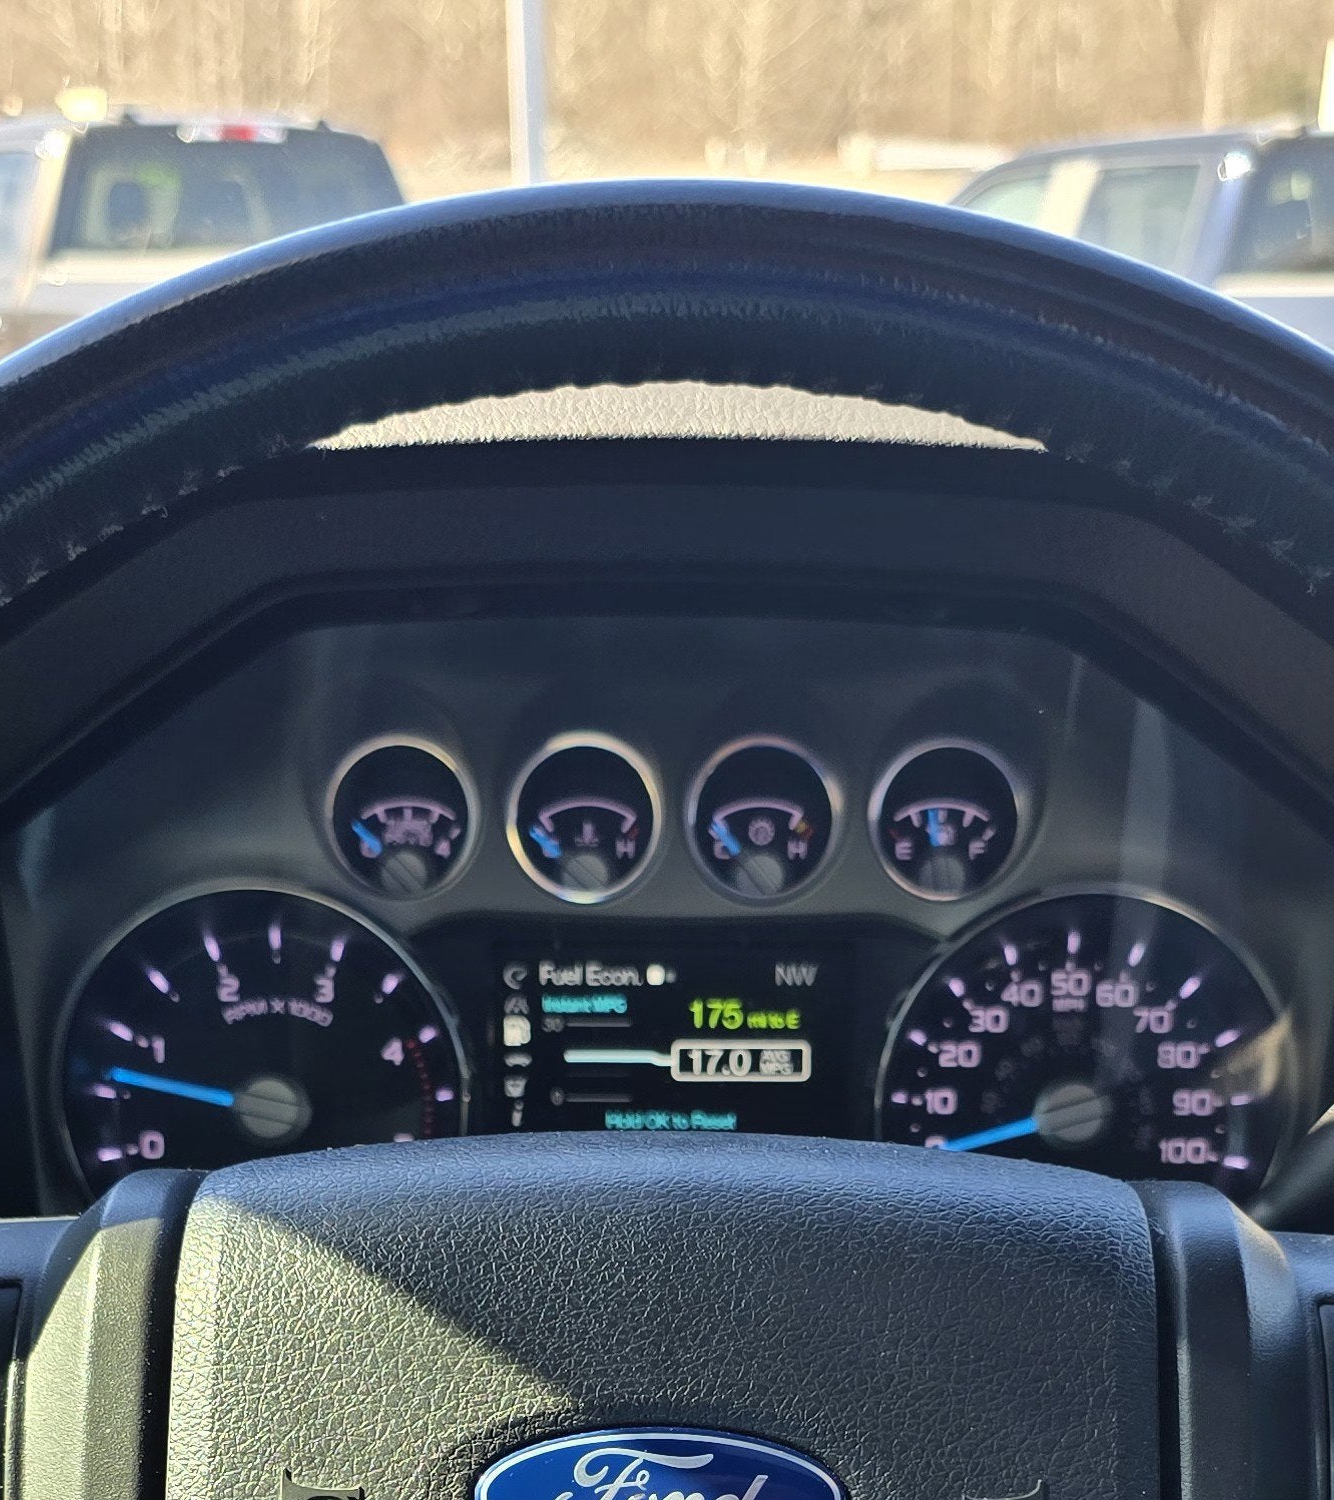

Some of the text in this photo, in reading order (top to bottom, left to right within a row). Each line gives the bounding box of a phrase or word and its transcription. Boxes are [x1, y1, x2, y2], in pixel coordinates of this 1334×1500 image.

[217, 973, 241, 1002] 2
[313, 973, 335, 1002] 3
[539, 960, 584, 986] Fuel
[774, 961, 818, 987] NW
[1050, 968, 1093, 997] 50
[1000, 979, 1045, 1008] 40
[1095, 979, 1140, 1008] 60
[688, 998, 744, 1030] 175
[968, 1005, 1010, 1034] 30
[1133, 1004, 1174, 1034] 70
[380, 1037, 405, 1066] 4
[687, 1049, 752, 1077] 17.0
[938, 1040, 983, 1069] 20
[1157, 1041, 1202, 1069] 80
[925, 1087, 959, 1116] 10
[1173, 1088, 1216, 1116] 90
[139, 1129, 165, 1160] 0
[1159, 1137, 1213, 1164] 100
